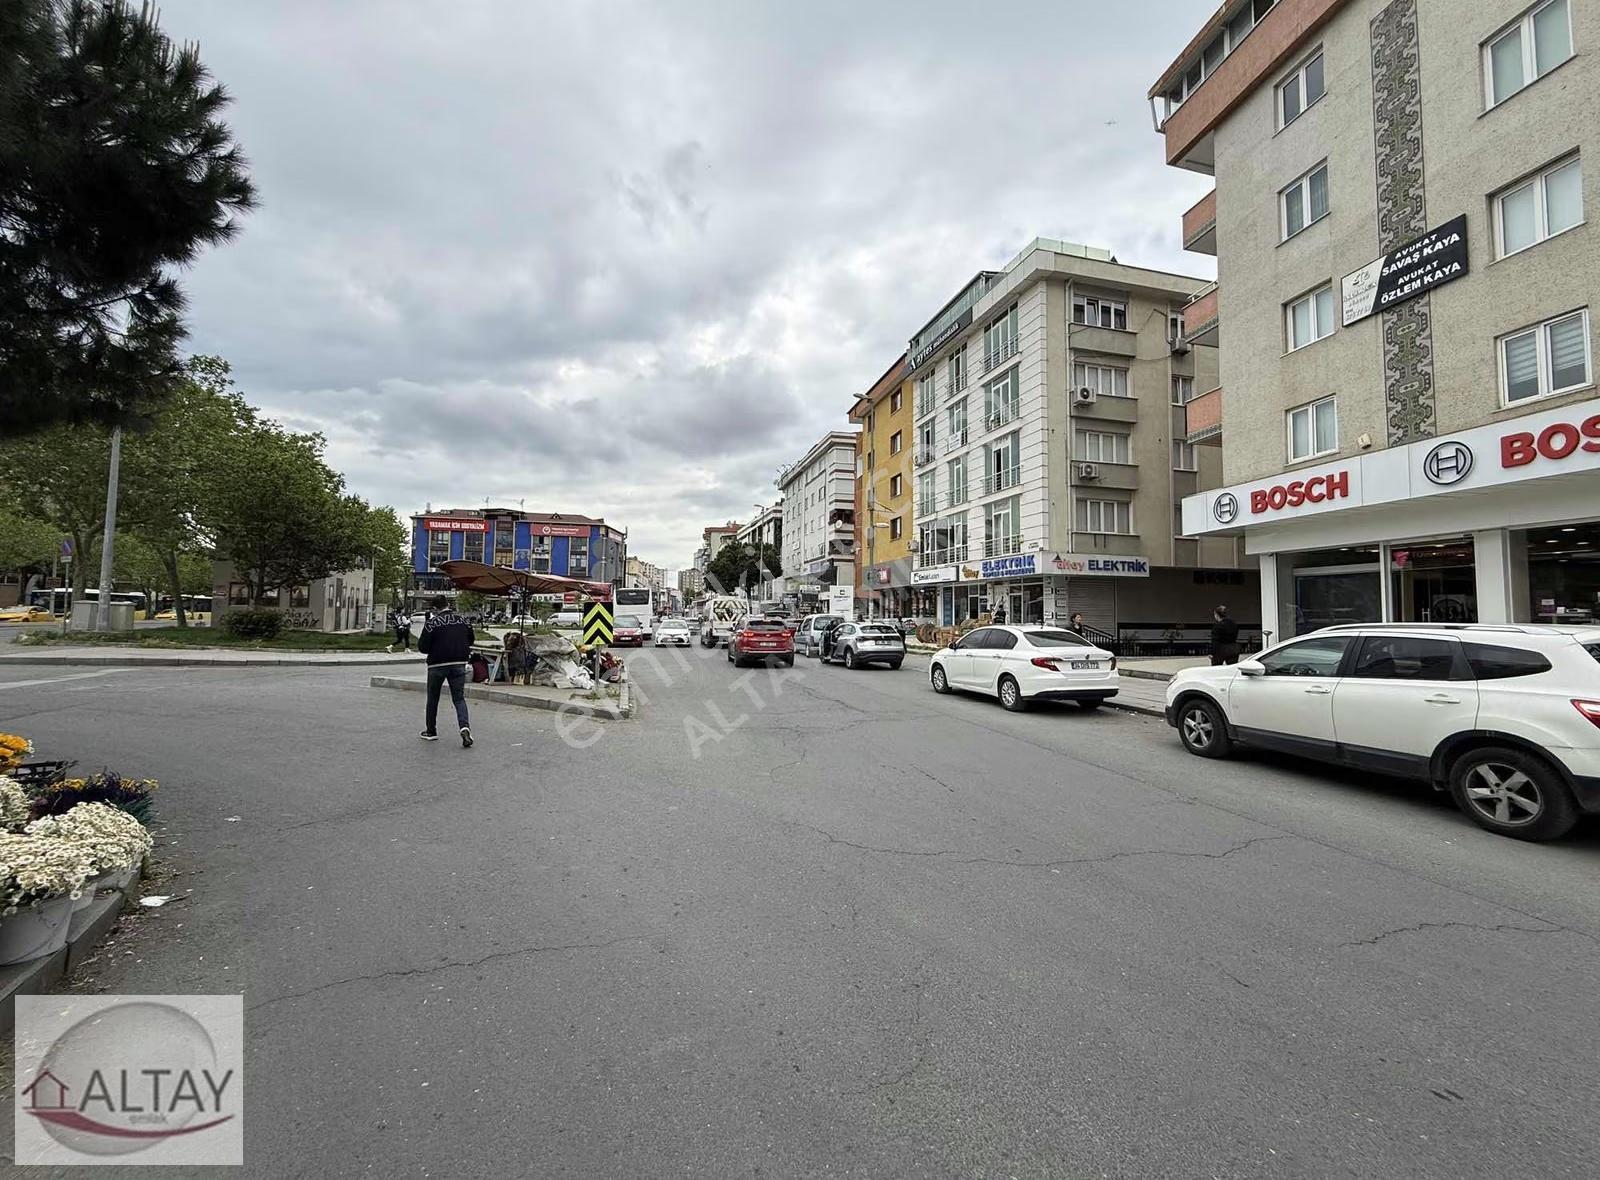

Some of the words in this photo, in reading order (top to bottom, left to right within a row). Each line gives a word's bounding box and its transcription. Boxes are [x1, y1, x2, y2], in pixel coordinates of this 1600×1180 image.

[1381, 251, 1421, 277] SAVAŞ
[1423, 232, 1460, 257] KAYA
[1395, 234, 1438, 259] AVUKAT
[1381, 280, 1421, 304] ÖZLEM
[1424, 262, 1461, 286] KAYA
[1398, 260, 1439, 285] AVUKAT
[1250, 470, 1349, 514] BOSCH
[982, 554, 1036, 571] ELEKTRİK
[1087, 558, 1147, 573] ELEKTRİK
